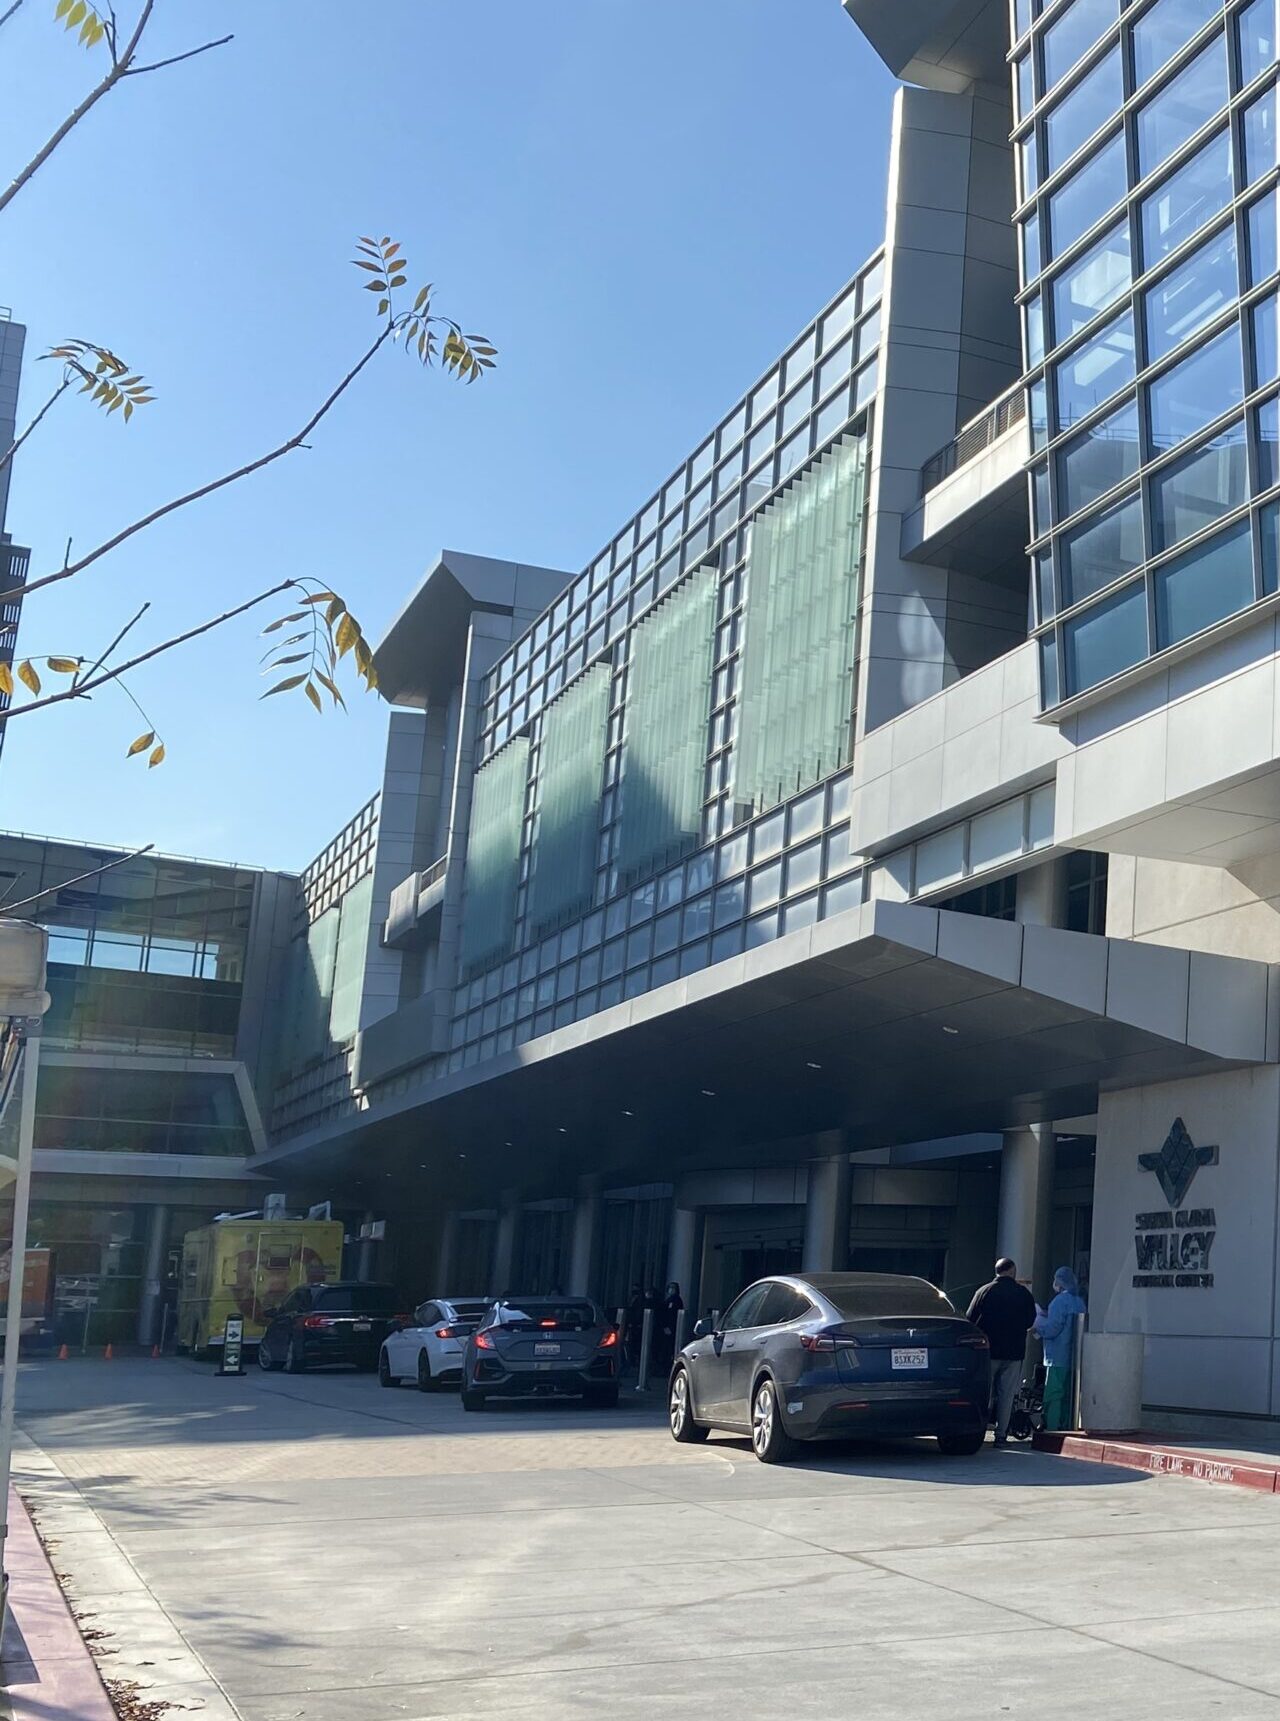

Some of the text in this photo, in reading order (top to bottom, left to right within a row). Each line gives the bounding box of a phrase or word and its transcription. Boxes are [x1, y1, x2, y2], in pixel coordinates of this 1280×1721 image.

[1149, 1454, 1165, 1470] FIRE
[1166, 1456, 1184, 1473] LANE
[1193, 1462, 1203, 1477] NO
[1204, 1463, 1234, 1481] PARKING
